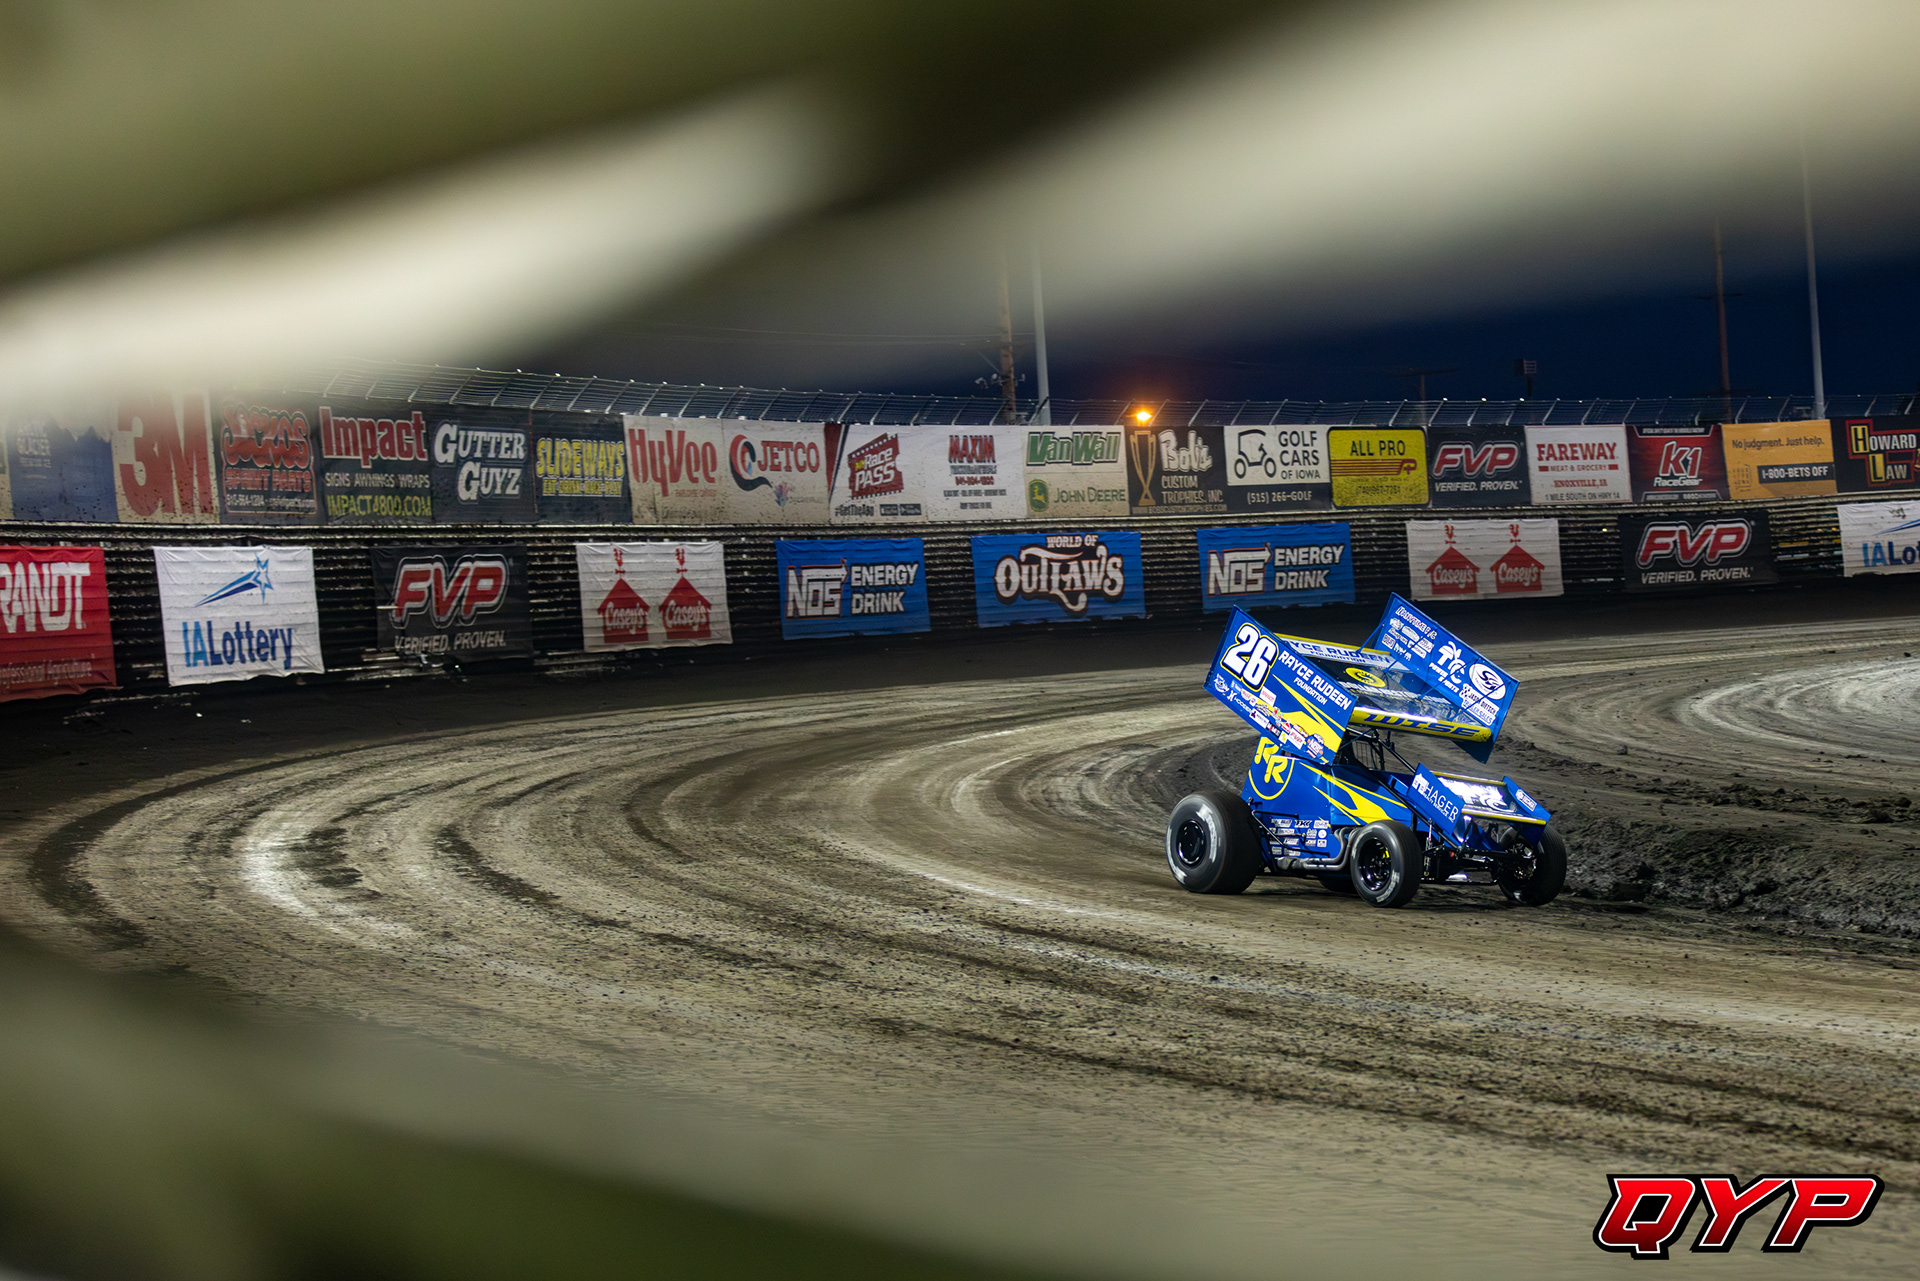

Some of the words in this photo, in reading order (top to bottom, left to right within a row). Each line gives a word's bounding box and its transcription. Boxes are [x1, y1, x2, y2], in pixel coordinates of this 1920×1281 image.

[319, 406, 428, 469] Impact
[434, 423, 526, 464] GUTTER
[949, 434, 996, 464] MAXIM
[1279, 430, 1318, 447] GOLF
[1350, 440, 1374, 456] ALL
[1379, 439, 1406, 456] PRO
[1732, 439, 1744, 449] No
[1744, 437, 1784, 451] judgment.
[1785, 436, 1802, 447] Just
[1803, 435, 1825, 448] help.
[1851, 425, 1917, 453] HOWARD
[117, 388, 214, 516] 3M
[536, 438, 625, 478] SLIDEWAYS
[758, 440, 821, 473] JETCO
[1280, 449, 1320, 466] CARS
[1433, 441, 1520, 477] FVP
[1536, 442, 1617, 462] FAREWAY
[1659, 440, 1702, 479] K1
[324, 472, 351, 487] SIGNS
[354, 473, 395, 488] AWNINGS
[398, 474, 430, 489] WRAPS
[457, 461, 523, 501] GUYZ
[855, 461, 895, 492] PASS
[1281, 469, 1293, 480] OF
[1296, 469, 1320, 480] IOWA
[1551, 464, 1568, 472] MEAT
[1812, 465, 1829, 477] OFF
[1870, 453, 1907, 483] LAW
[1054, 488, 1086, 504] JOHN
[1087, 486, 1126, 503] DEERE
[1161, 475, 1198, 489] CUSTOM
[1435, 482, 1478, 492] VERIFIED.
[1247, 492, 1269, 505] (515)
[1272, 491, 1312, 502] 266-GOLF
[1565, 492, 1586, 501] SOUTH
[1046, 535, 1082, 549] WORLD
[1084, 534, 1098, 547] OF
[1639, 522, 1749, 566] FVP
[1862, 541, 1920, 568] IALo
[1274, 545, 1345, 567] ENERGY
[850, 563, 919, 586] ENERGY
[1207, 543, 1271, 596] NOS
[1274, 570, 1329, 590] DRINK
[1433, 563, 1475, 588] Casey's
[1499, 562, 1539, 587] Casey's
[1641, 572, 1697, 585] VERIFIED.
[1700, 567, 1751, 580] PROVEN.
[394, 558, 507, 622] FVP
[786, 559, 849, 619] NOS
[851, 591, 905, 614] DRINK
[605, 602, 645, 634] Casey's
[666, 600, 707, 632] Casey's
[182, 620, 293, 670] IALottery
[454, 630, 507, 648] PROVEN.
[1222, 625, 1277, 687] 26
[1278, 650, 1314, 683] RAYCE
[1312, 675, 1353, 711] RUDEEN
[1293, 676, 1328, 706] FOUNDATION
[1363, 713, 1480, 737] WISE
[1424, 785, 1459, 820] HAGER
